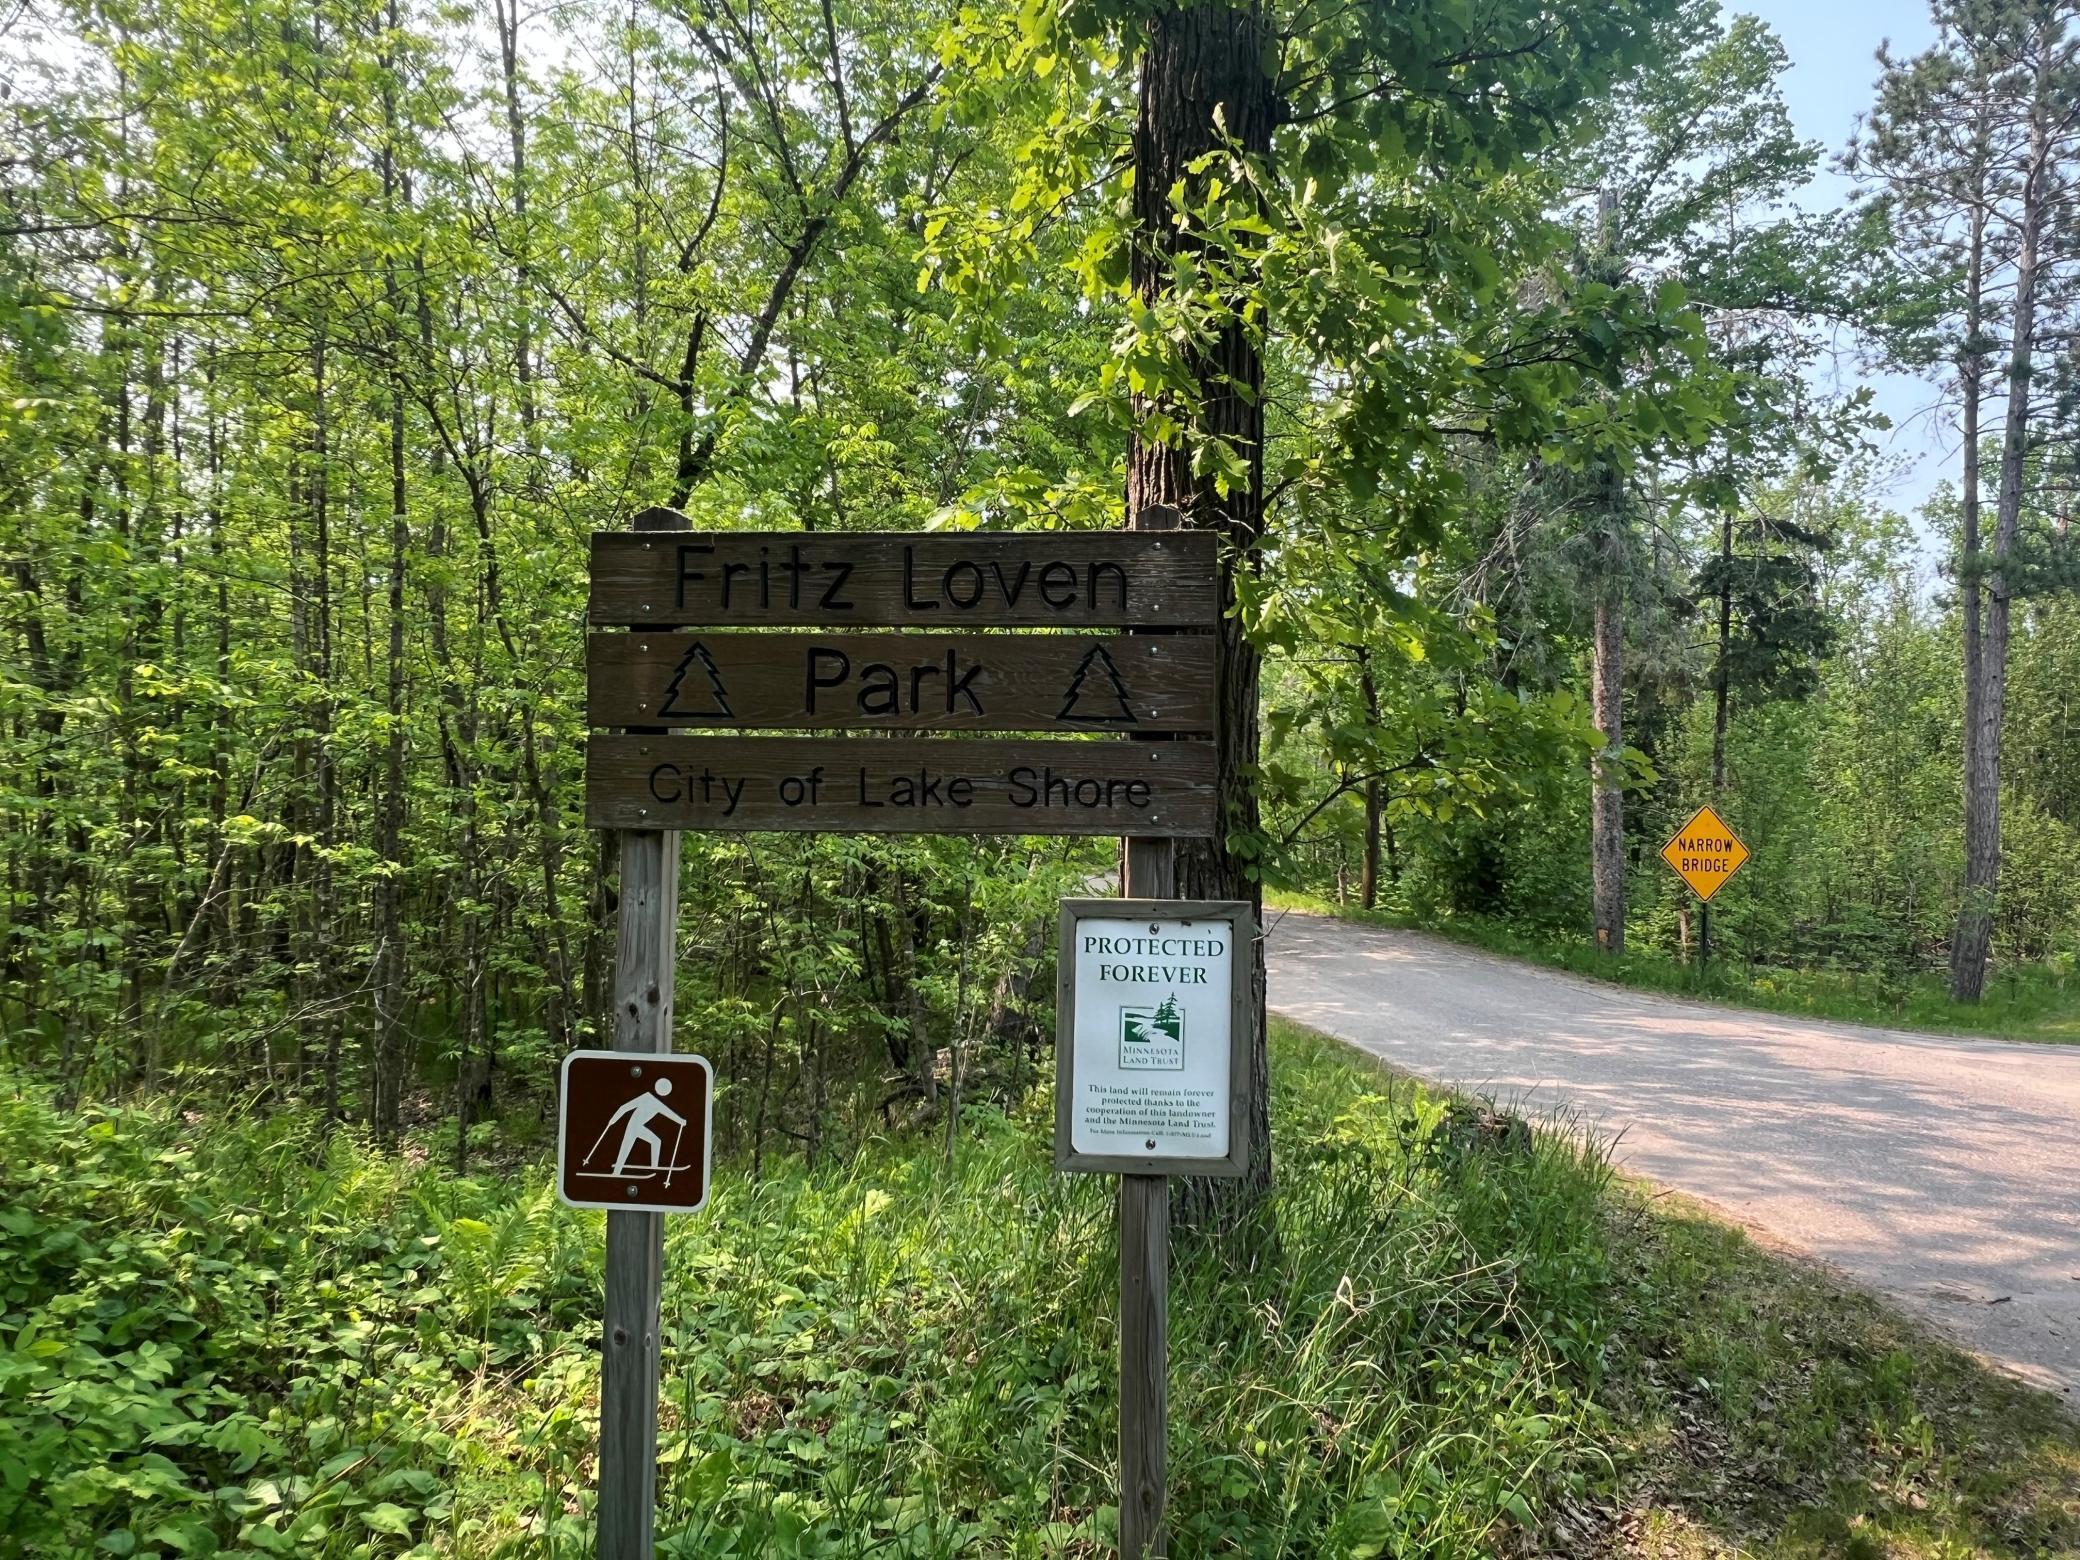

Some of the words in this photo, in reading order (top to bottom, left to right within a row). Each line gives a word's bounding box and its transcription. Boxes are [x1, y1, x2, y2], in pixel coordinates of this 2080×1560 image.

[675, 543, 855, 611] Fritz
[902, 543, 1128, 611] Loven
[804, 646, 986, 717] Park
[648, 763, 746, 817] City
[778, 766, 825, 807] of
[859, 766, 975, 809] Lake
[1008, 765, 1153, 810] Shore
[1678, 838, 1733, 852] NARROW
[1682, 858, 1729, 872] BRIDGE
[1084, 936, 1224, 957] PROTECTED
[1099, 964, 1208, 984] FOREVER
[1088, 1084, 1107, 1094] This
[1109, 1085, 1129, 1095] land
[1131, 1087, 1149, 1096] will
[1150, 1088, 1181, 1097] remain
[1183, 1088, 1215, 1097] forever
[1101, 1097, 1142, 1106] protected
[1144, 1098, 1174, 1107] thanks
[1176, 1099, 1185, 1107] to
[1186, 1099, 1201, 1107] the
[1086, 1106, 1137, 1117] cooperation
[1138, 1107, 1148, 1116] of
[1150, 1108, 1167, 1117] this
[1168, 1109, 1216, 1118] landowner
[1084, 1116, 1101, 1124] and
[1103, 1116, 1117, 1125] the
[1119, 1117, 1166, 1126] Minnesota
[1168, 1119, 1190, 1128] Land
[1193, 1119, 1216, 1128] Trust.
